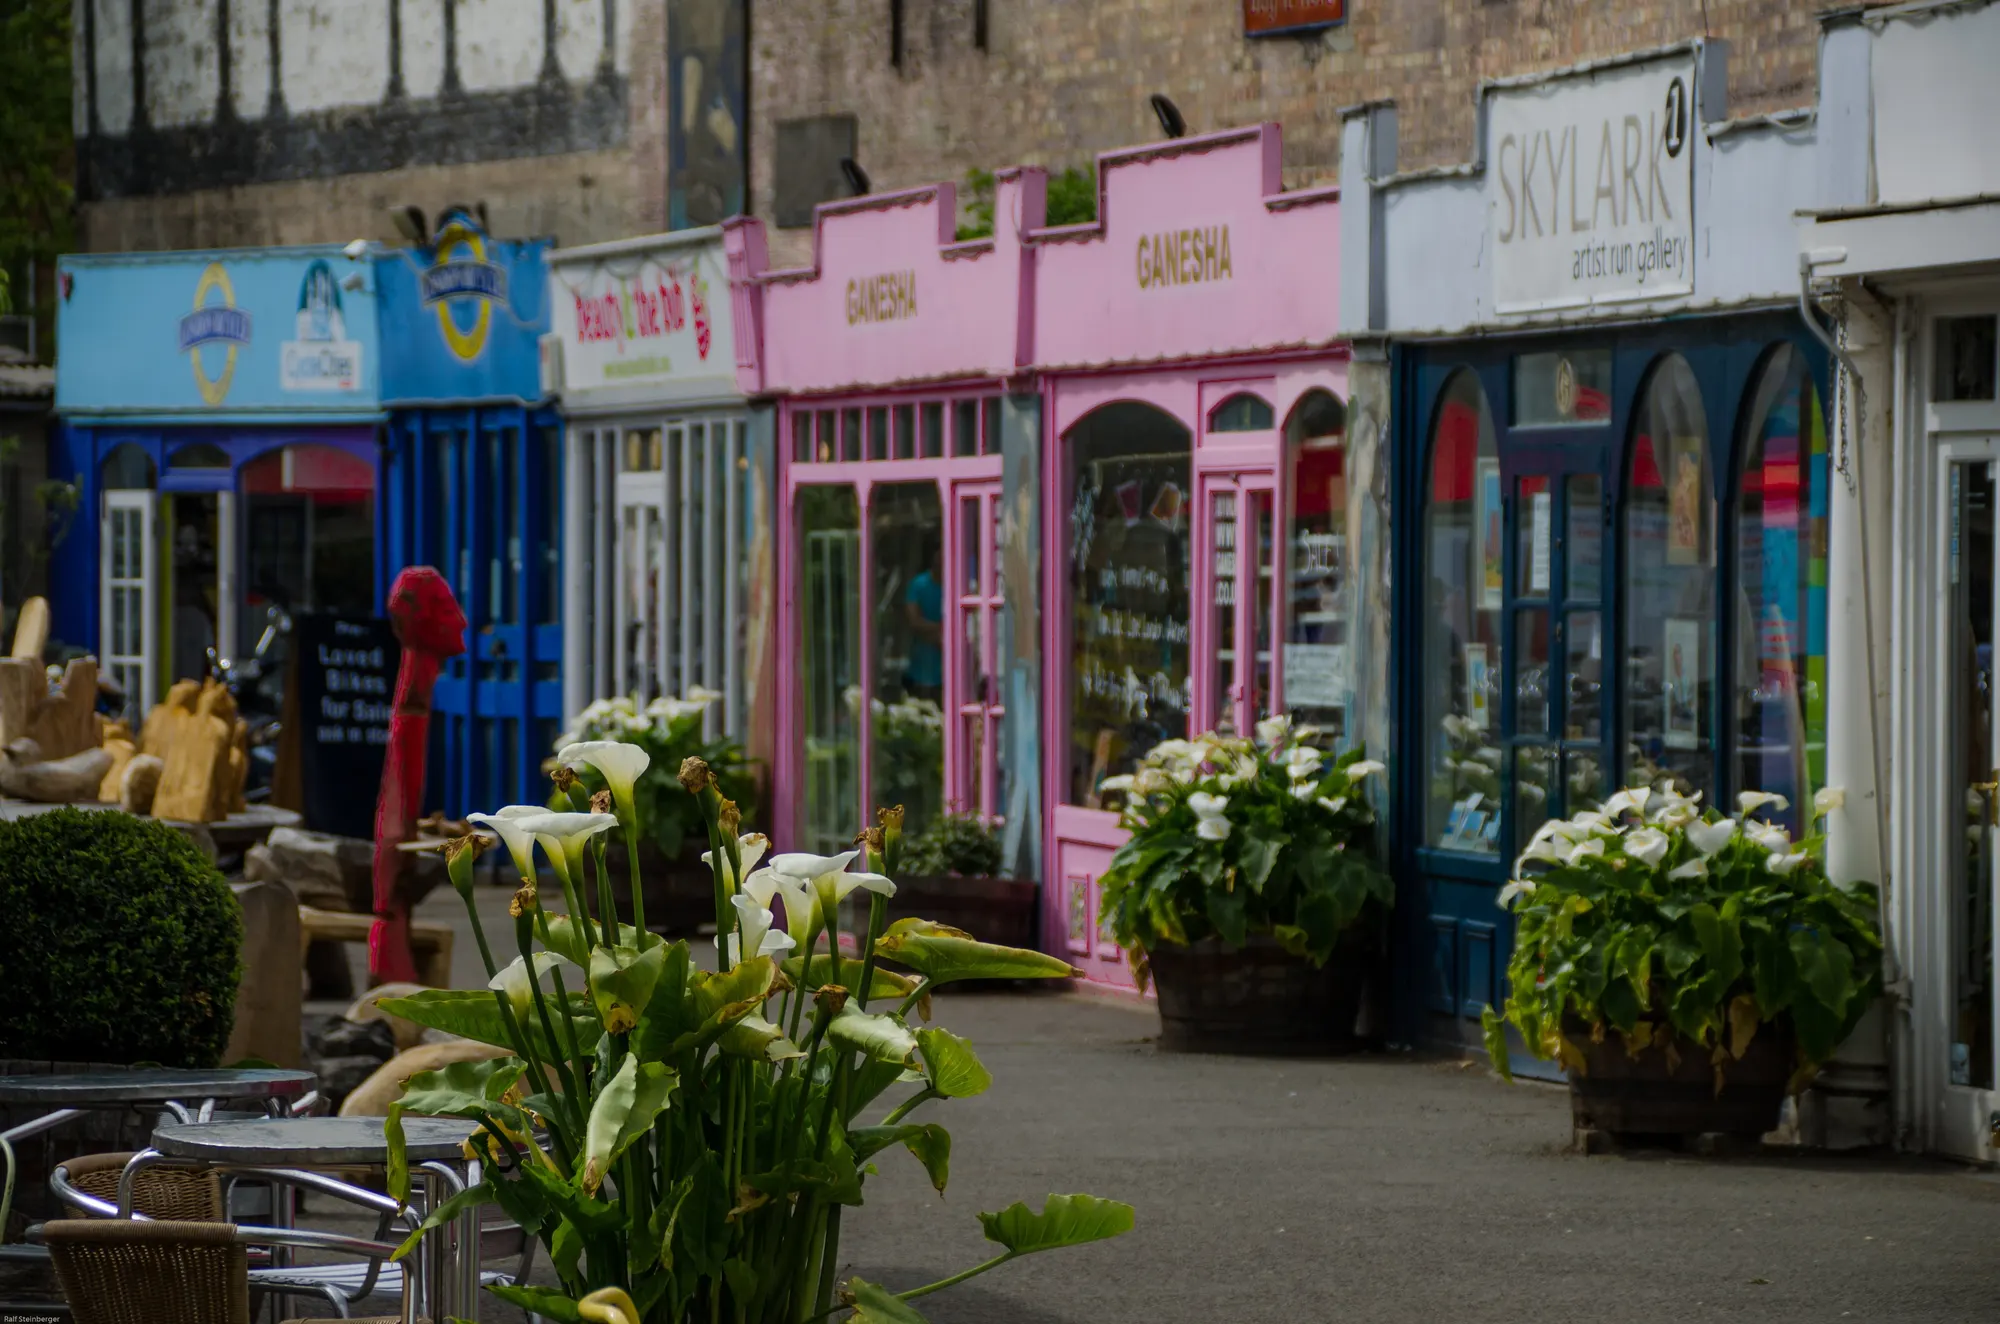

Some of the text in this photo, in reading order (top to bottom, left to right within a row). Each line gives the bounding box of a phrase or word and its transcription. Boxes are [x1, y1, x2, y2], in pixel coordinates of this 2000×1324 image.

[1499, 111, 1672, 244] SKYLARK
[1137, 224, 1233, 290] GANESHA
[1572, 227, 1687, 285] artist run gallery
[845, 269, 918, 326] GANESHA
[318, 643, 384, 668] Loved
[326, 668, 387, 695] Bikes
